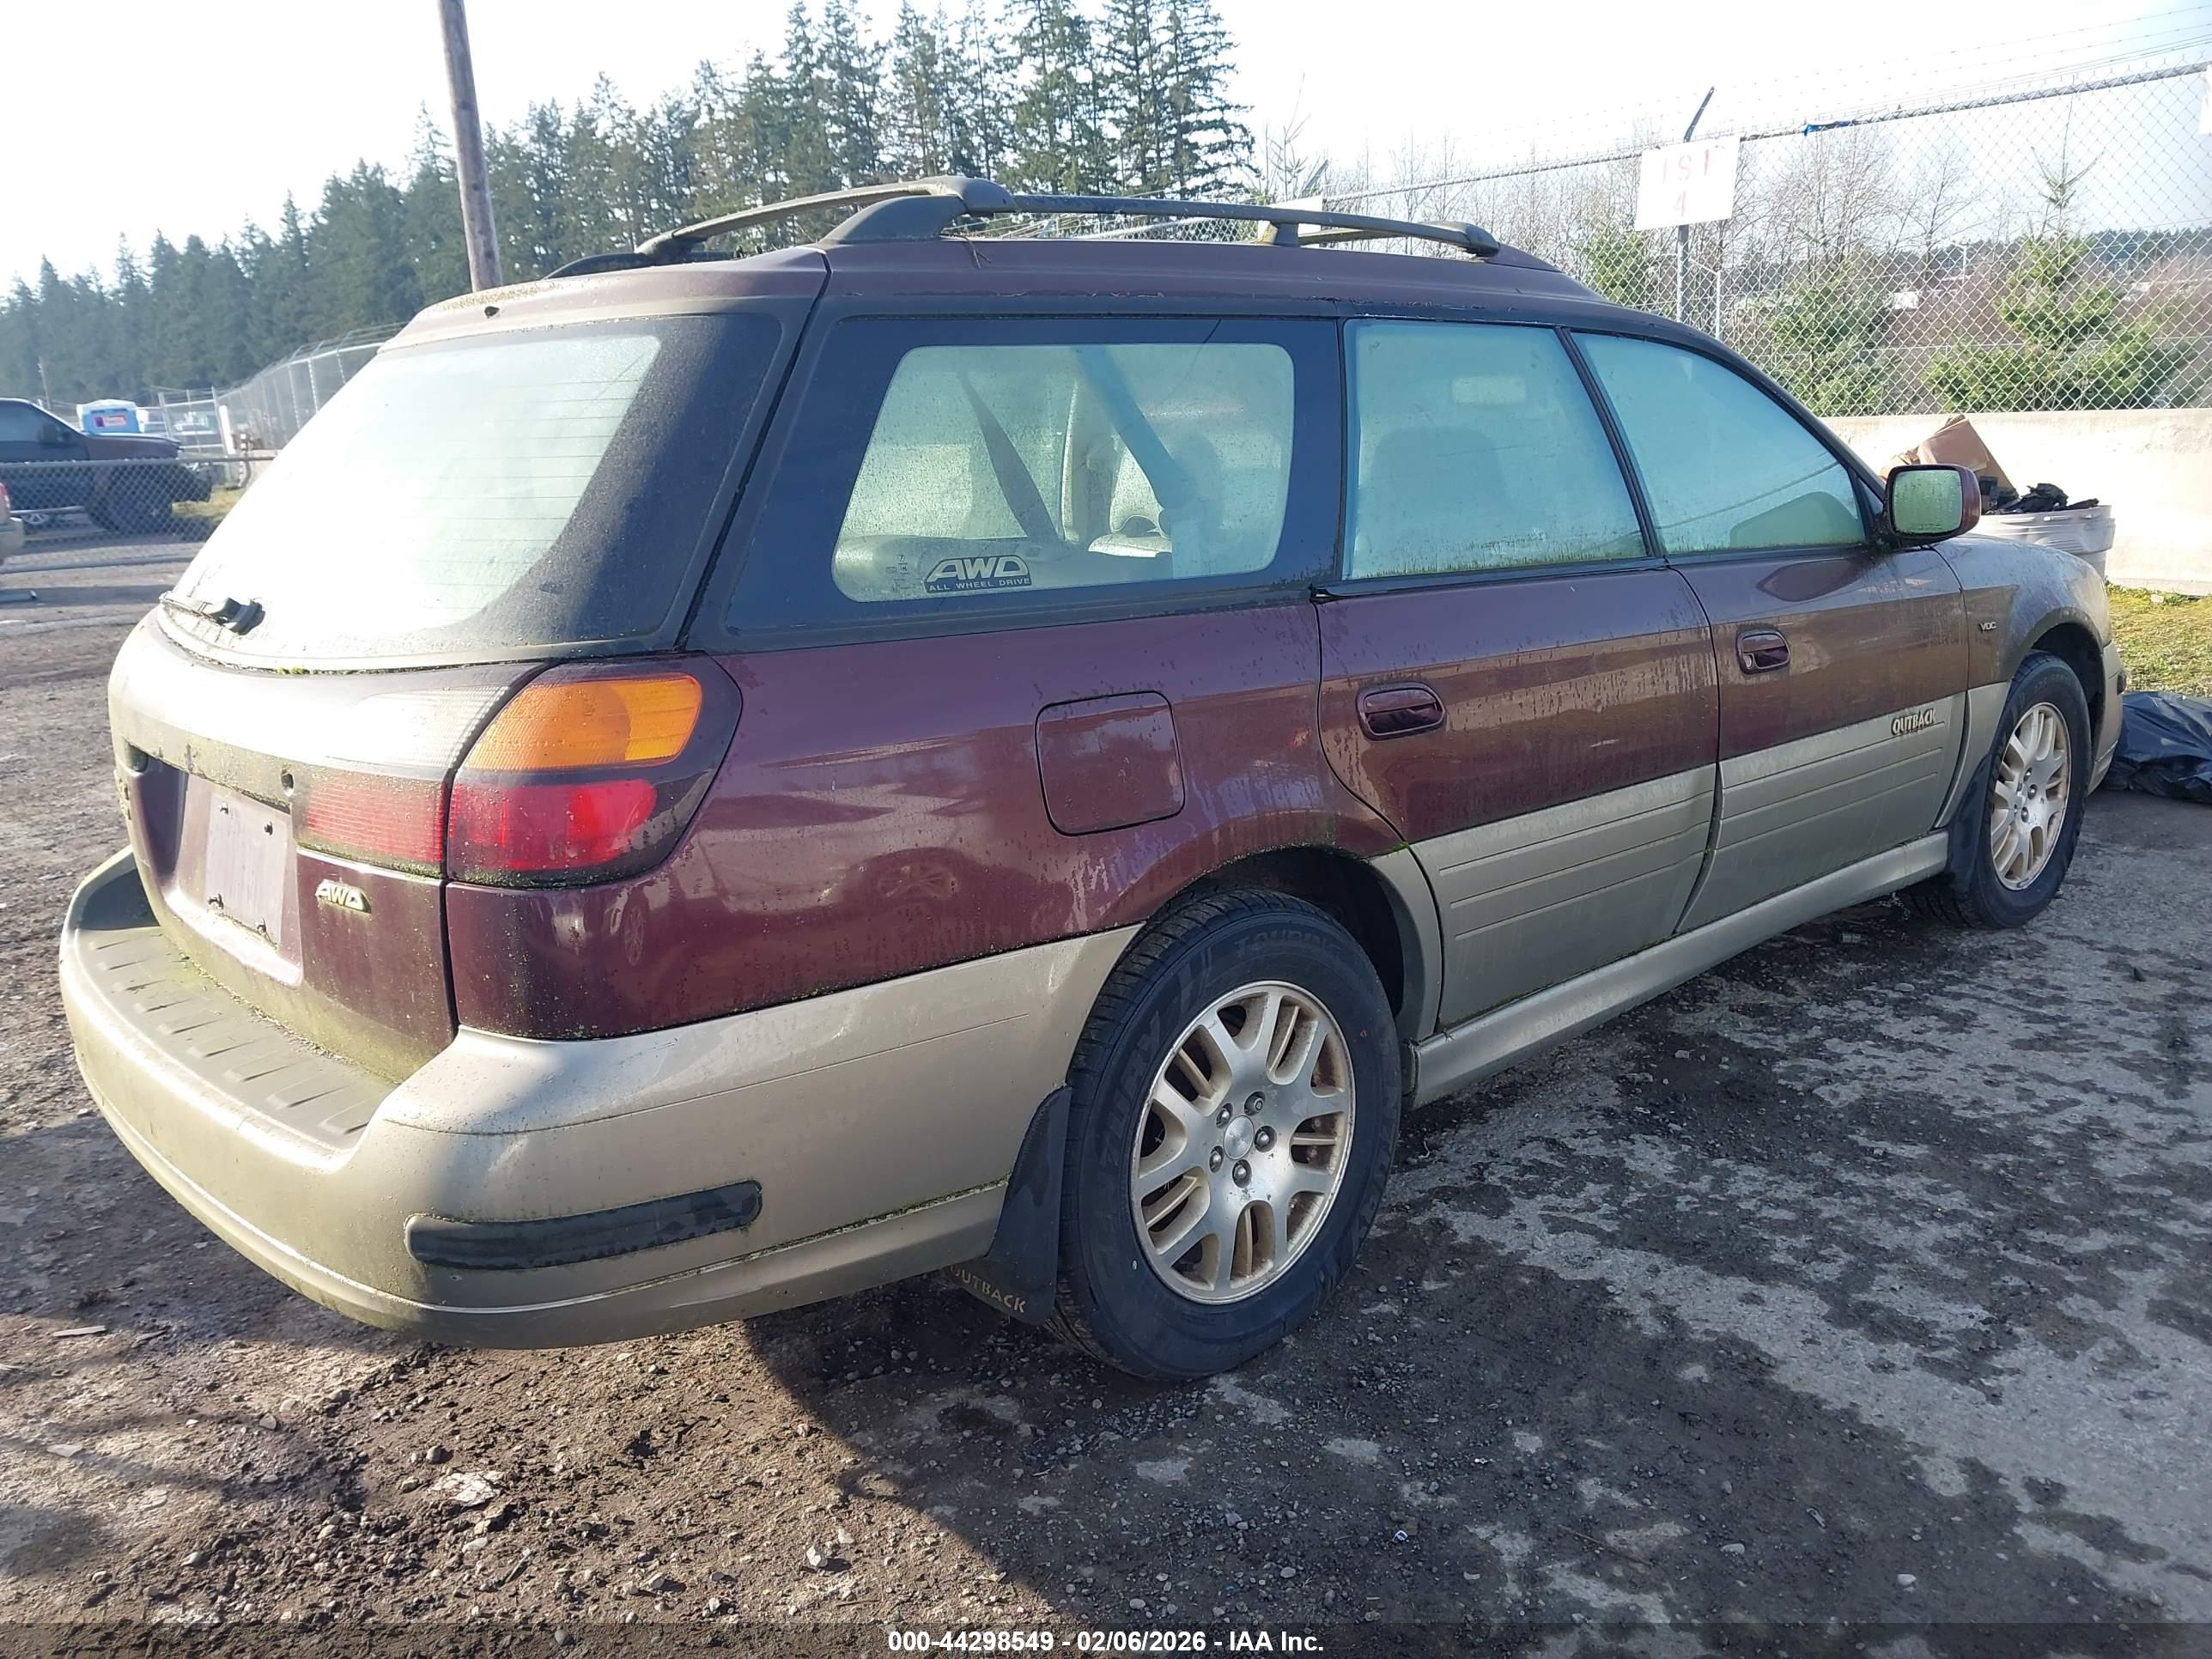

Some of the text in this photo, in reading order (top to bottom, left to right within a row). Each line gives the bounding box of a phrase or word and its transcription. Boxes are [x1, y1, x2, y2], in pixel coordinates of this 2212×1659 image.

[927, 555, 1030, 582] AWD
[928, 577, 1030, 592] ALL WHEEL DRIVE
[1979, 621, 1996, 631] VDC
[1892, 708, 1936, 735] OUTBACK
[315, 878, 365, 911] AWD
